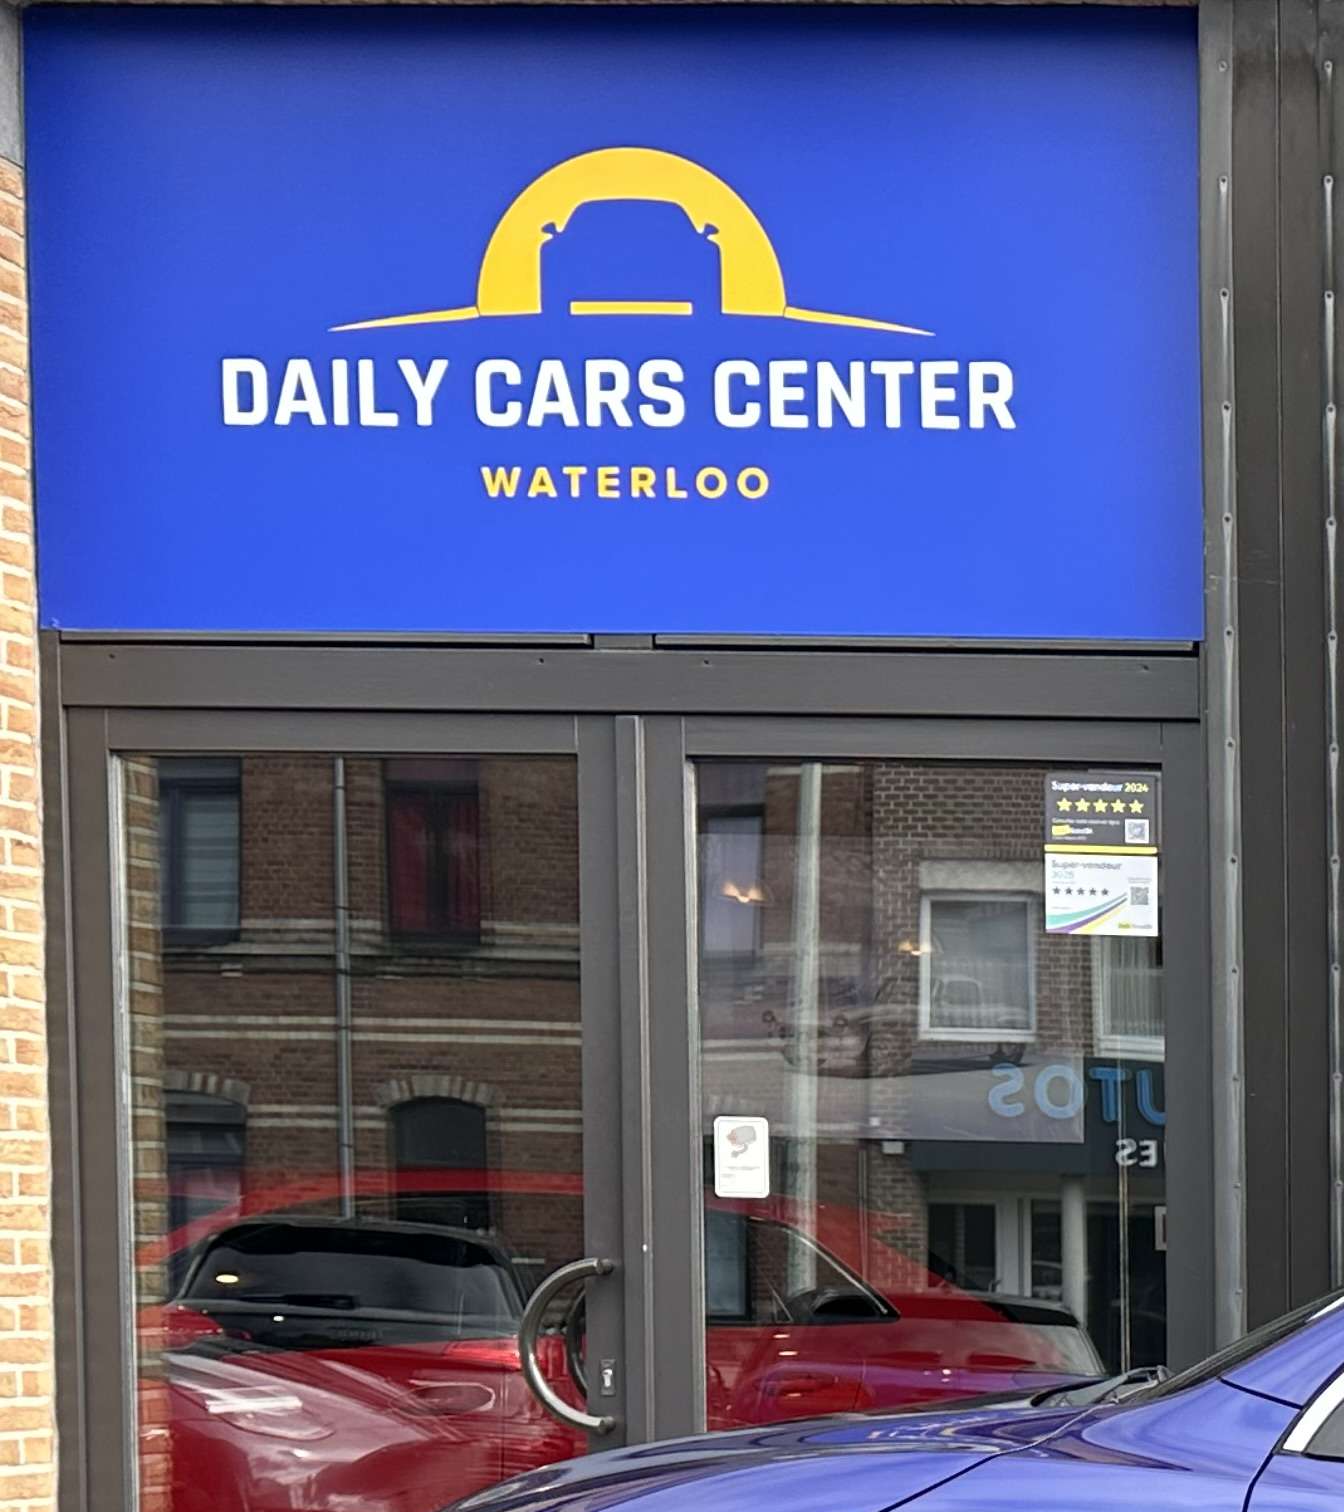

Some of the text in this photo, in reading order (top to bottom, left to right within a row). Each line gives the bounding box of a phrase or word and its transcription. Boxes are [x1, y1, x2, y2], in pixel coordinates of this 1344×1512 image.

[222, 358, 1017, 430] DAILY CARS CENTER
[480, 466, 770, 500] WATERLOO
[1124, 782, 1149, 793] 2024
